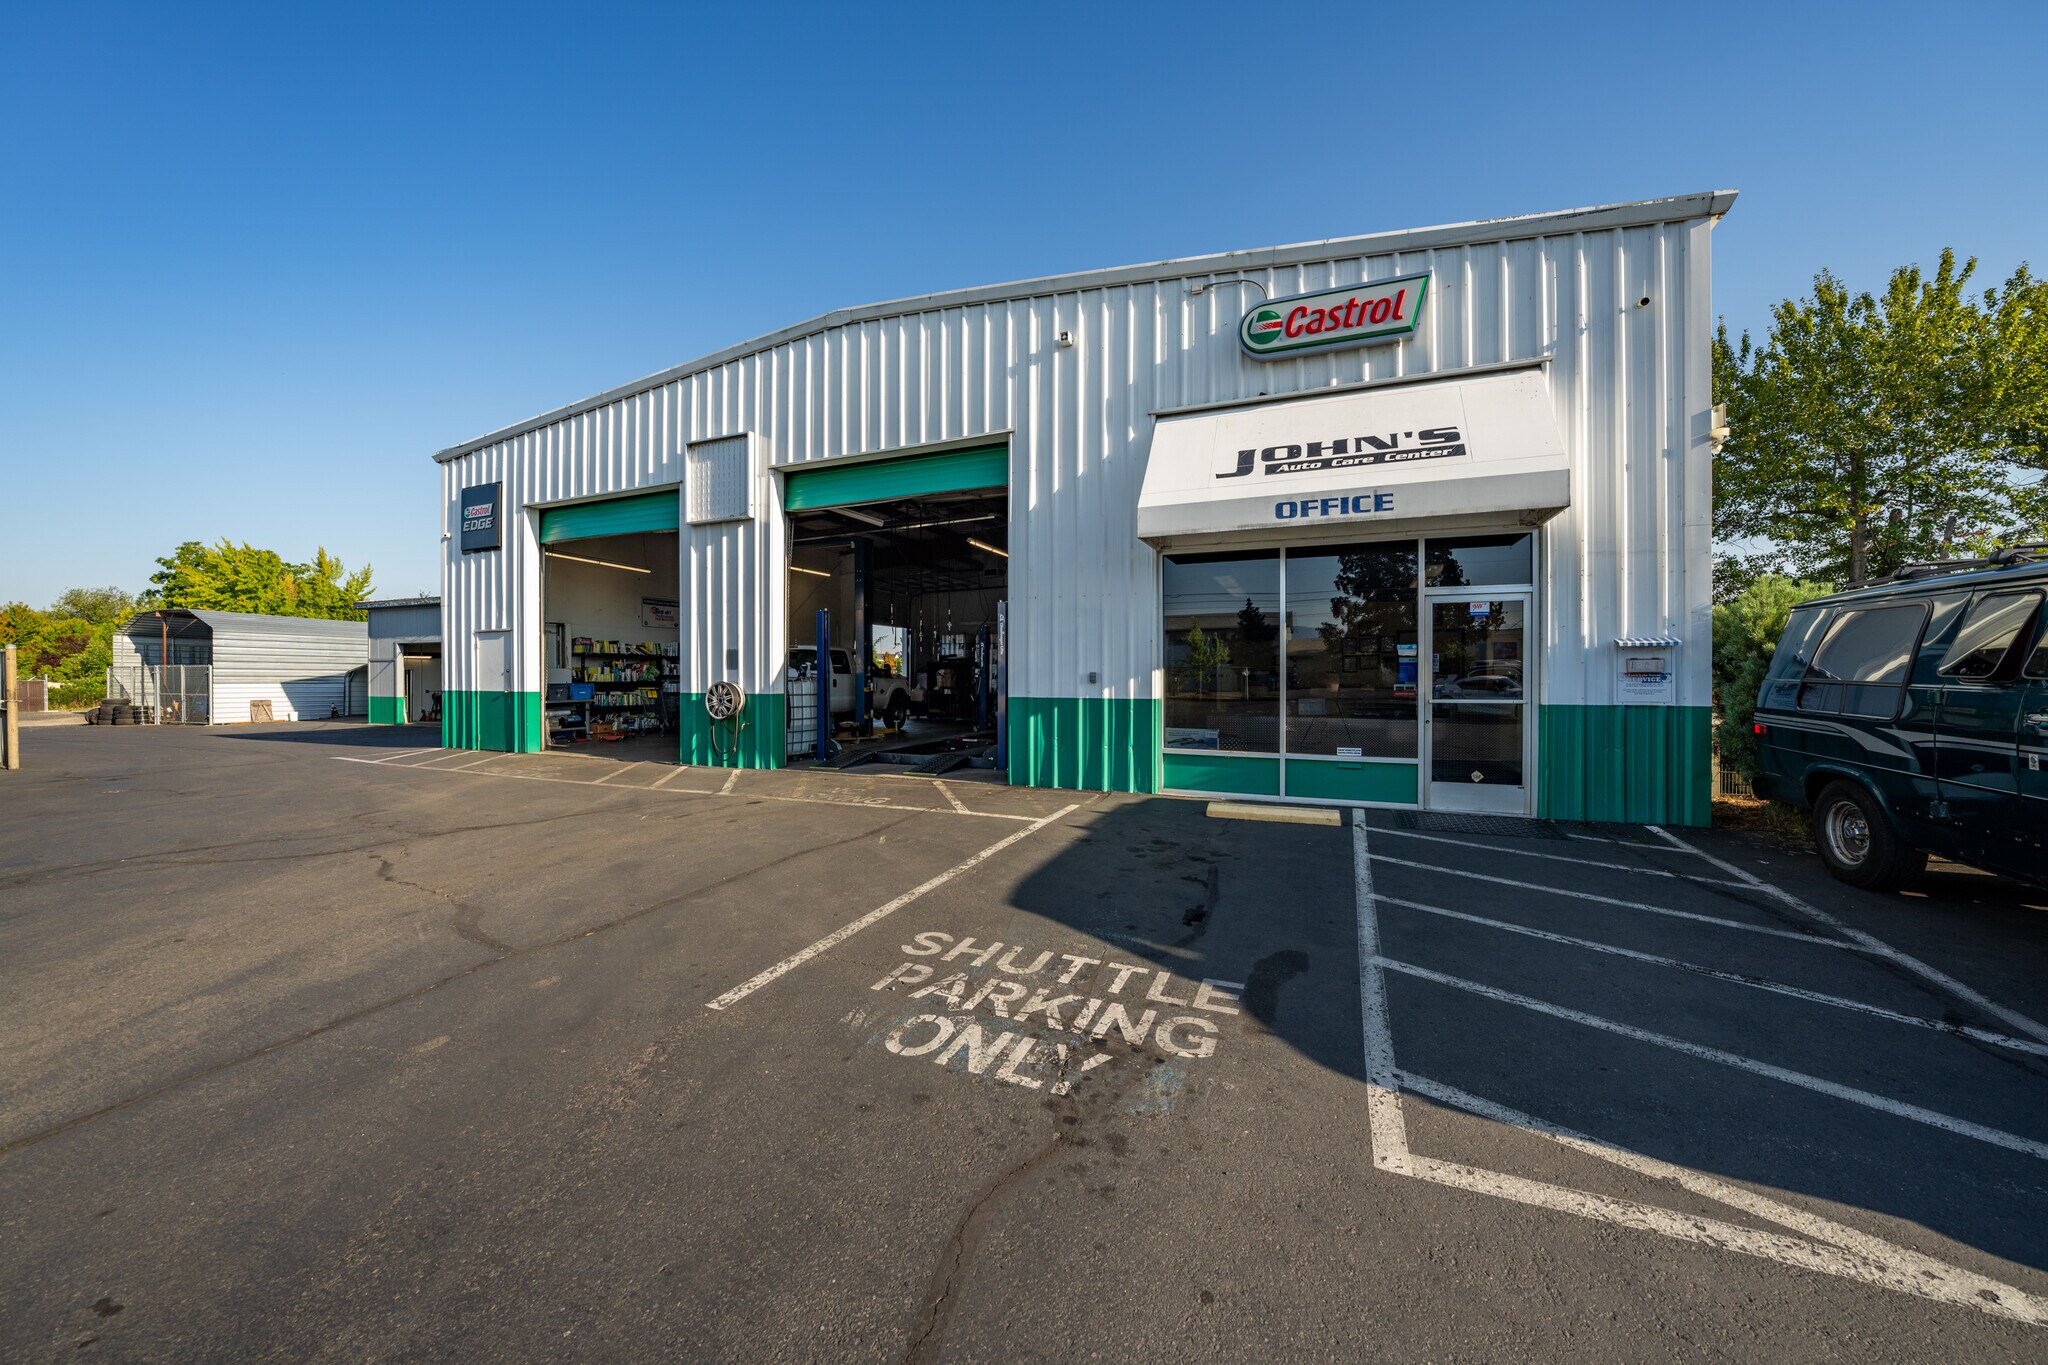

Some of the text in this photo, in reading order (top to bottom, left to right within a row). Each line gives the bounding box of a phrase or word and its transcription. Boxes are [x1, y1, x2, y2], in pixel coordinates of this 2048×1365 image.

[1284, 288, 1407, 338] Castrol
[1216, 426, 1462, 479] JOHN'S
[1275, 447, 1453, 473] Auto Care Center
[463, 517, 493, 532] EDGE
[470, 505, 490, 517] Castrol
[1275, 493, 1394, 520] OFFICE
[900, 931, 1245, 1015] SHUTTLE
[870, 962, 1220, 1058] PARKING
[885, 1014, 1114, 1096] ONLY
